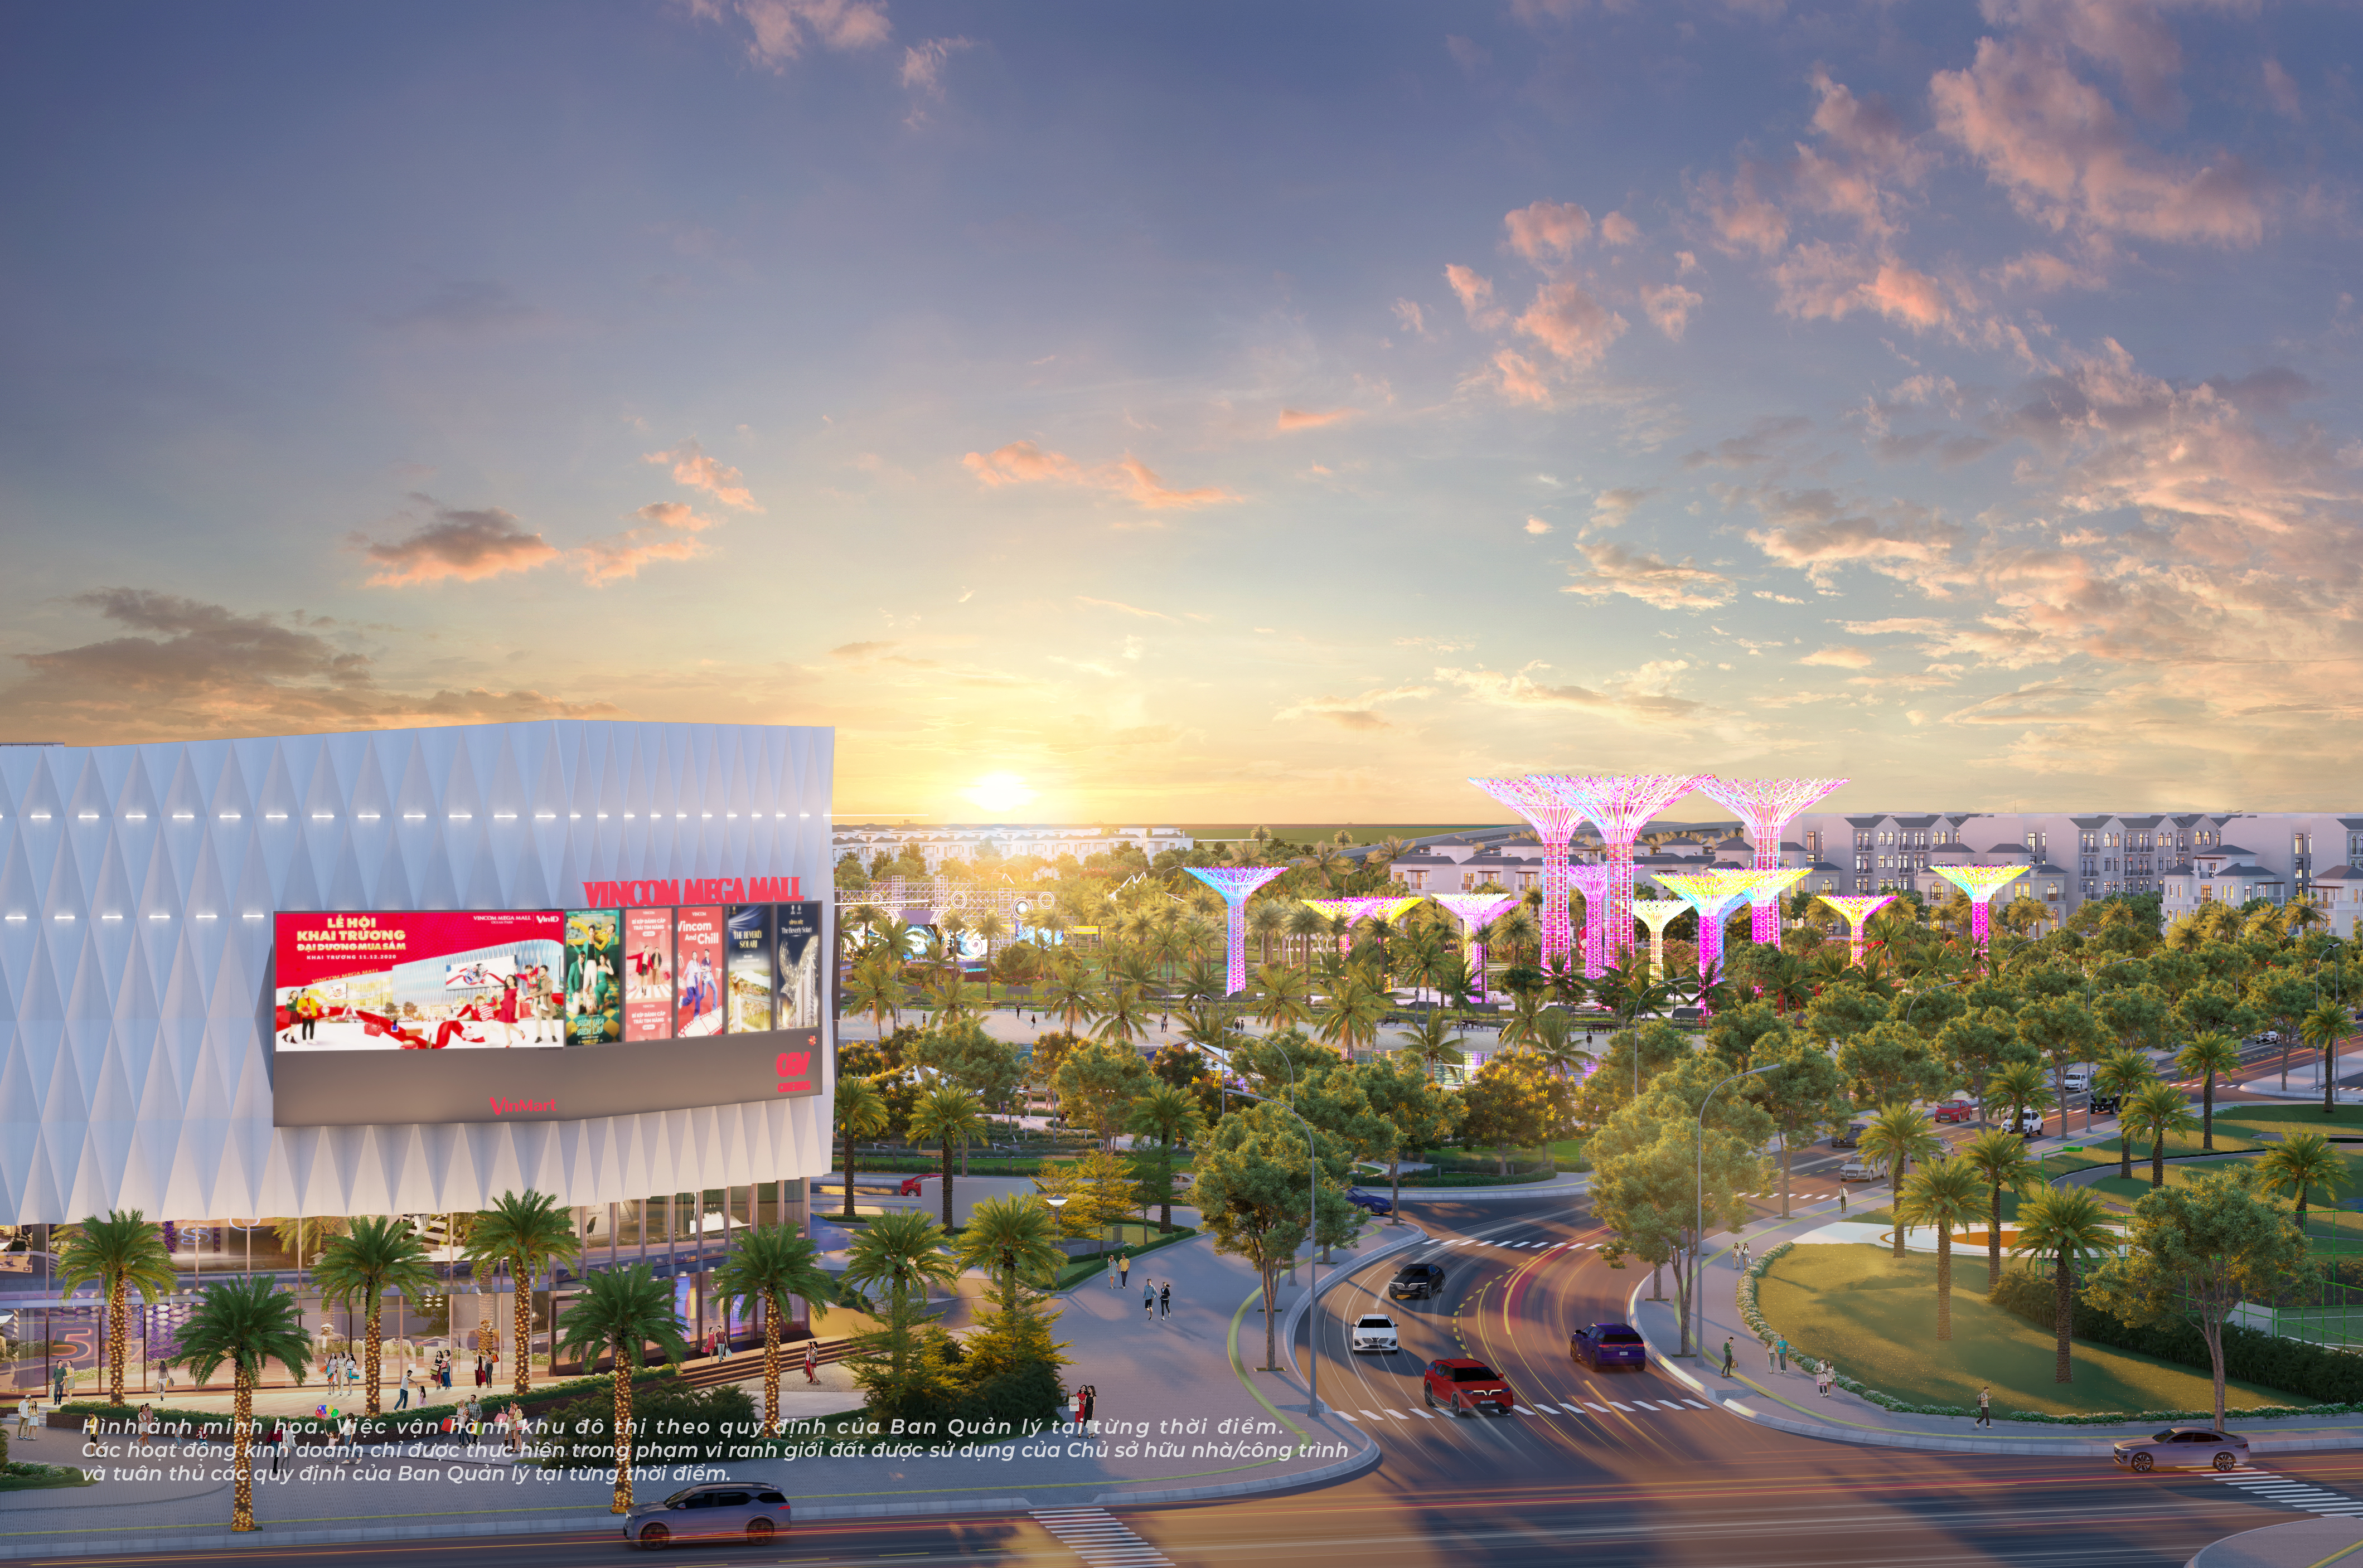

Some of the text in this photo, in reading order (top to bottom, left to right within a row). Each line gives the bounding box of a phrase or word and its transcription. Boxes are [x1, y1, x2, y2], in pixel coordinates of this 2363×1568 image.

[582, 876, 805, 908] VINCOM MEGA MALL
[328, 915, 376, 930] LỄ HỘI
[678, 921, 711, 932] Vincom
[297, 931, 336, 941] KHAI
[698, 933, 719, 944] Chill
[733, 930, 762, 940] THE BEVERLY
[297, 943, 316, 952] ĐẠI
[740, 940, 757, 949] SOLARI
[312, 975, 340, 983] VINCOM
[490, 1096, 556, 1115] VinMart
